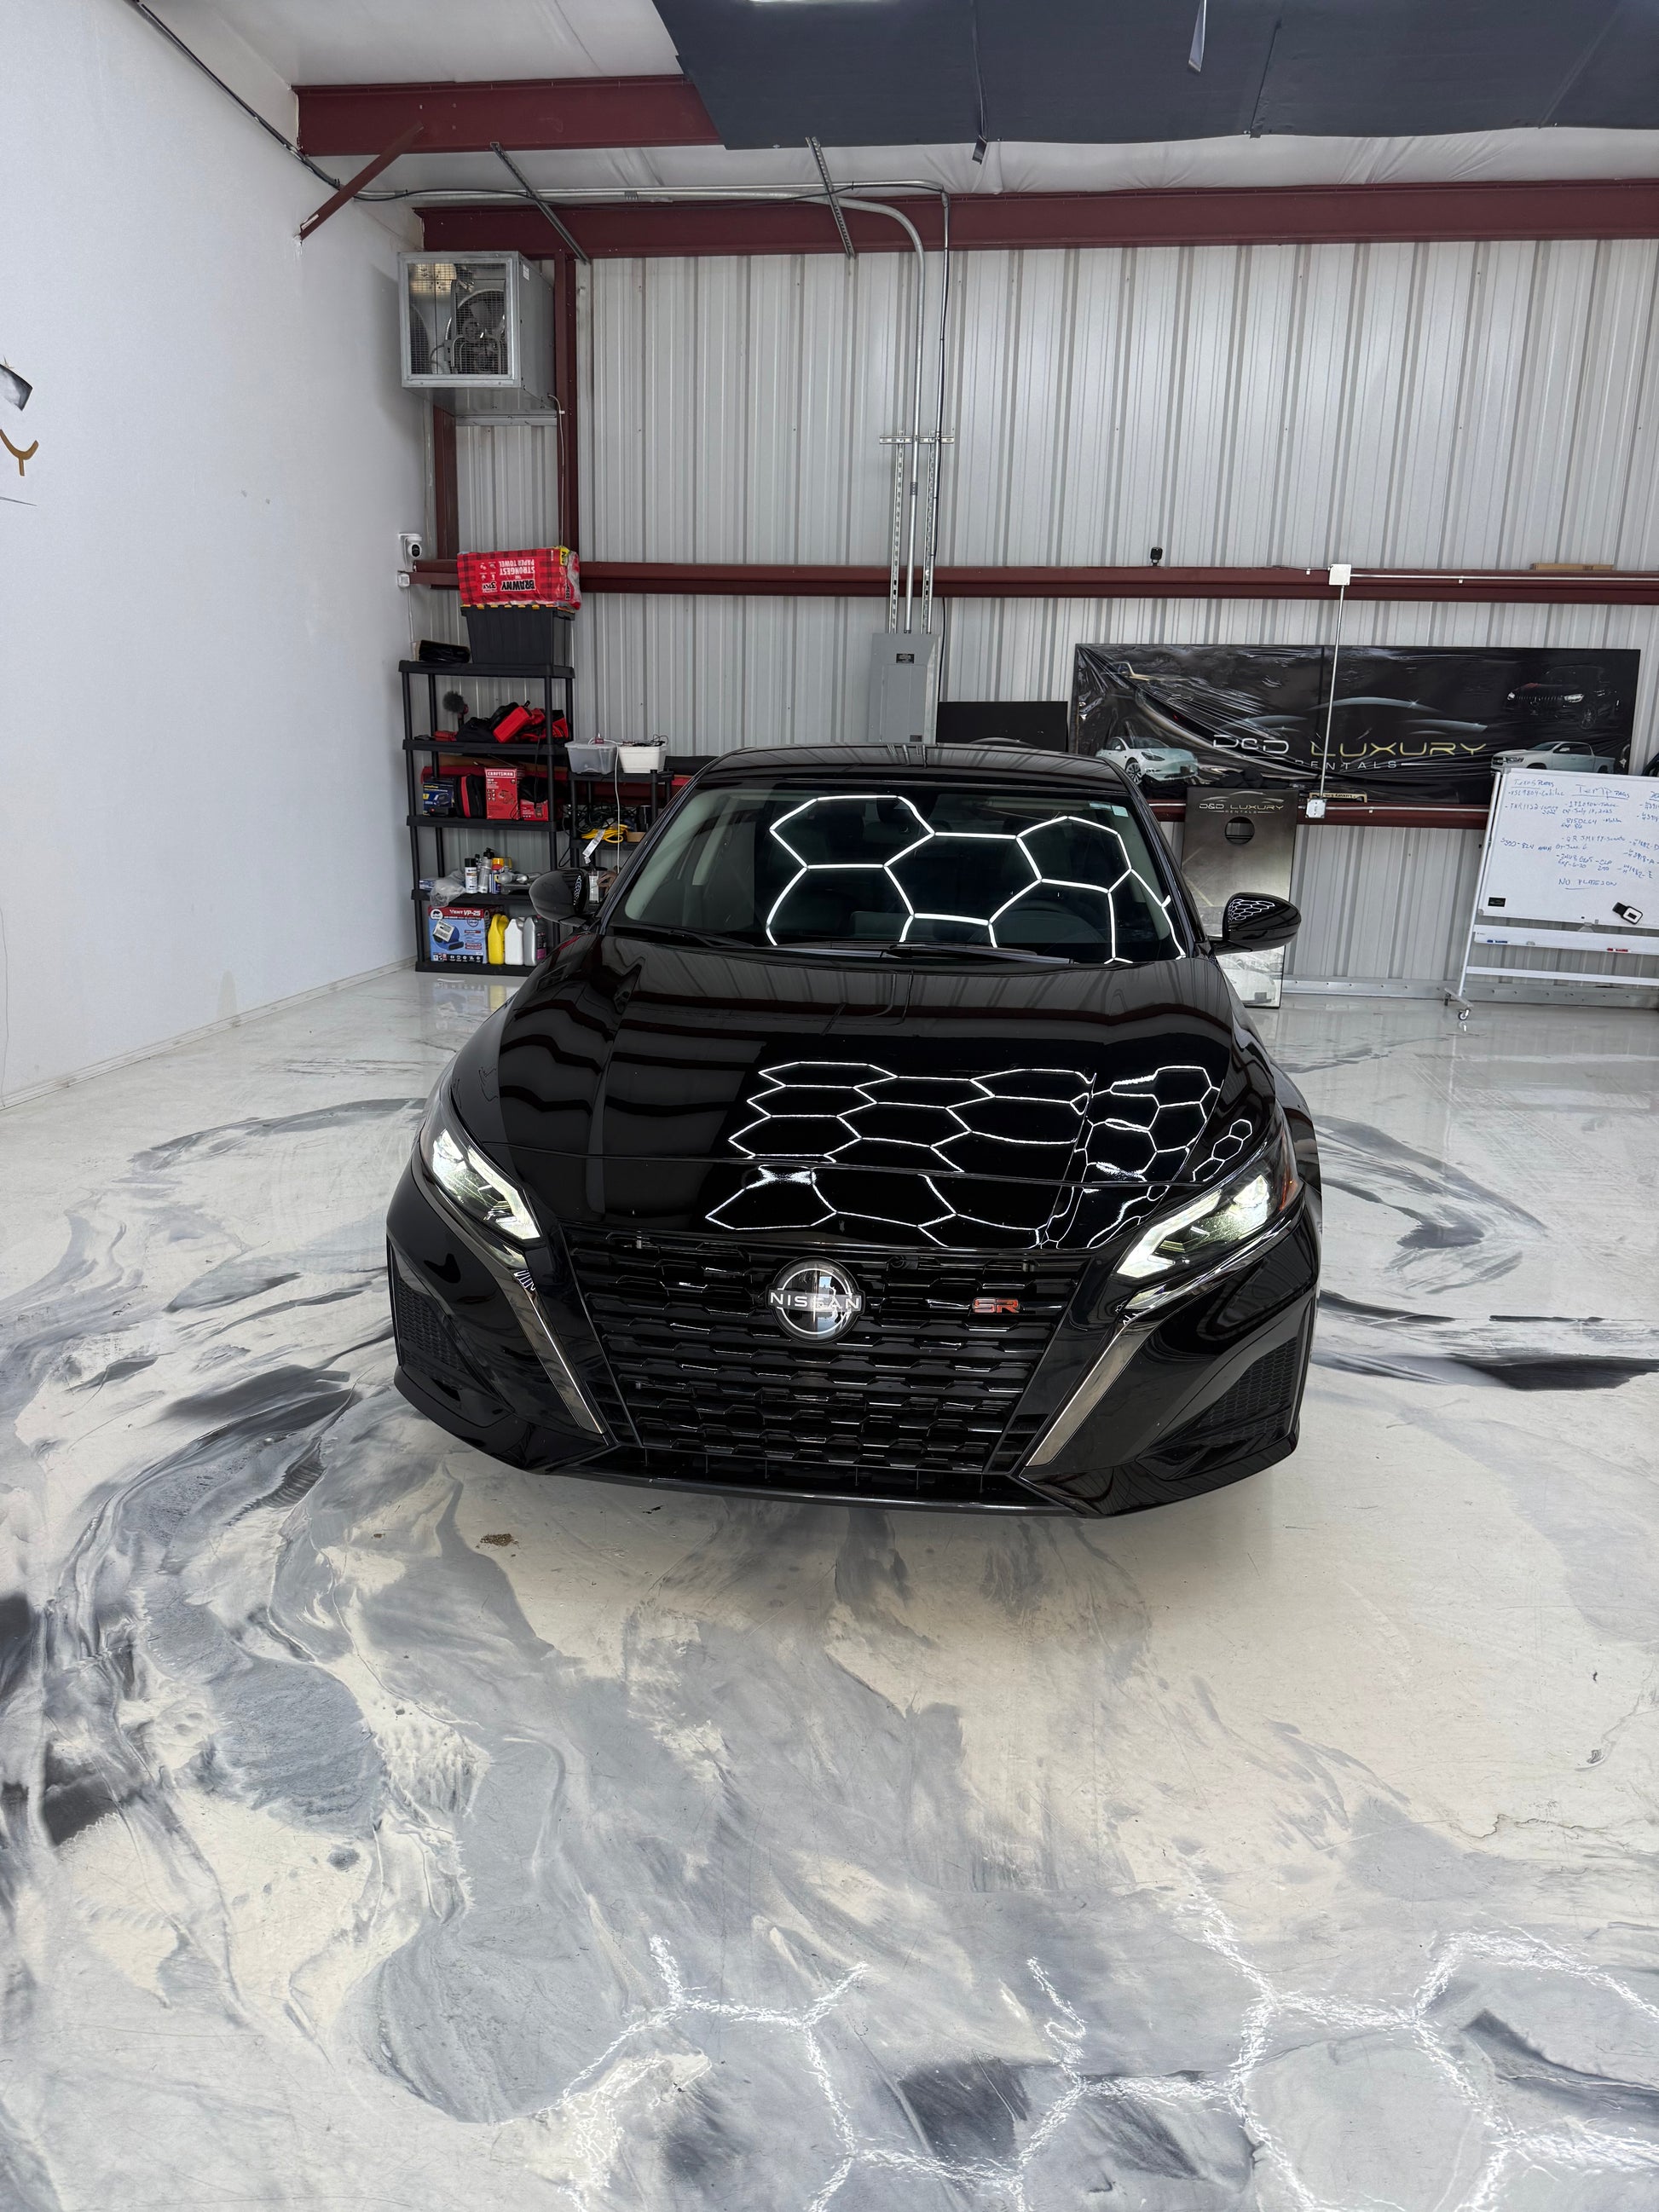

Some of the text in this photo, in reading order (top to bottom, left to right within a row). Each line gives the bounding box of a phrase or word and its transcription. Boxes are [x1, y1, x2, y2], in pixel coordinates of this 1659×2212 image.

[500, 566, 535, 575] STRONGEST
[500, 580, 536, 592] BRAWNY
[1310, 741, 1487, 756] LUXURY
[770, 1291, 860, 1310] NISSAN
[973, 1297, 1019, 1314] SR
